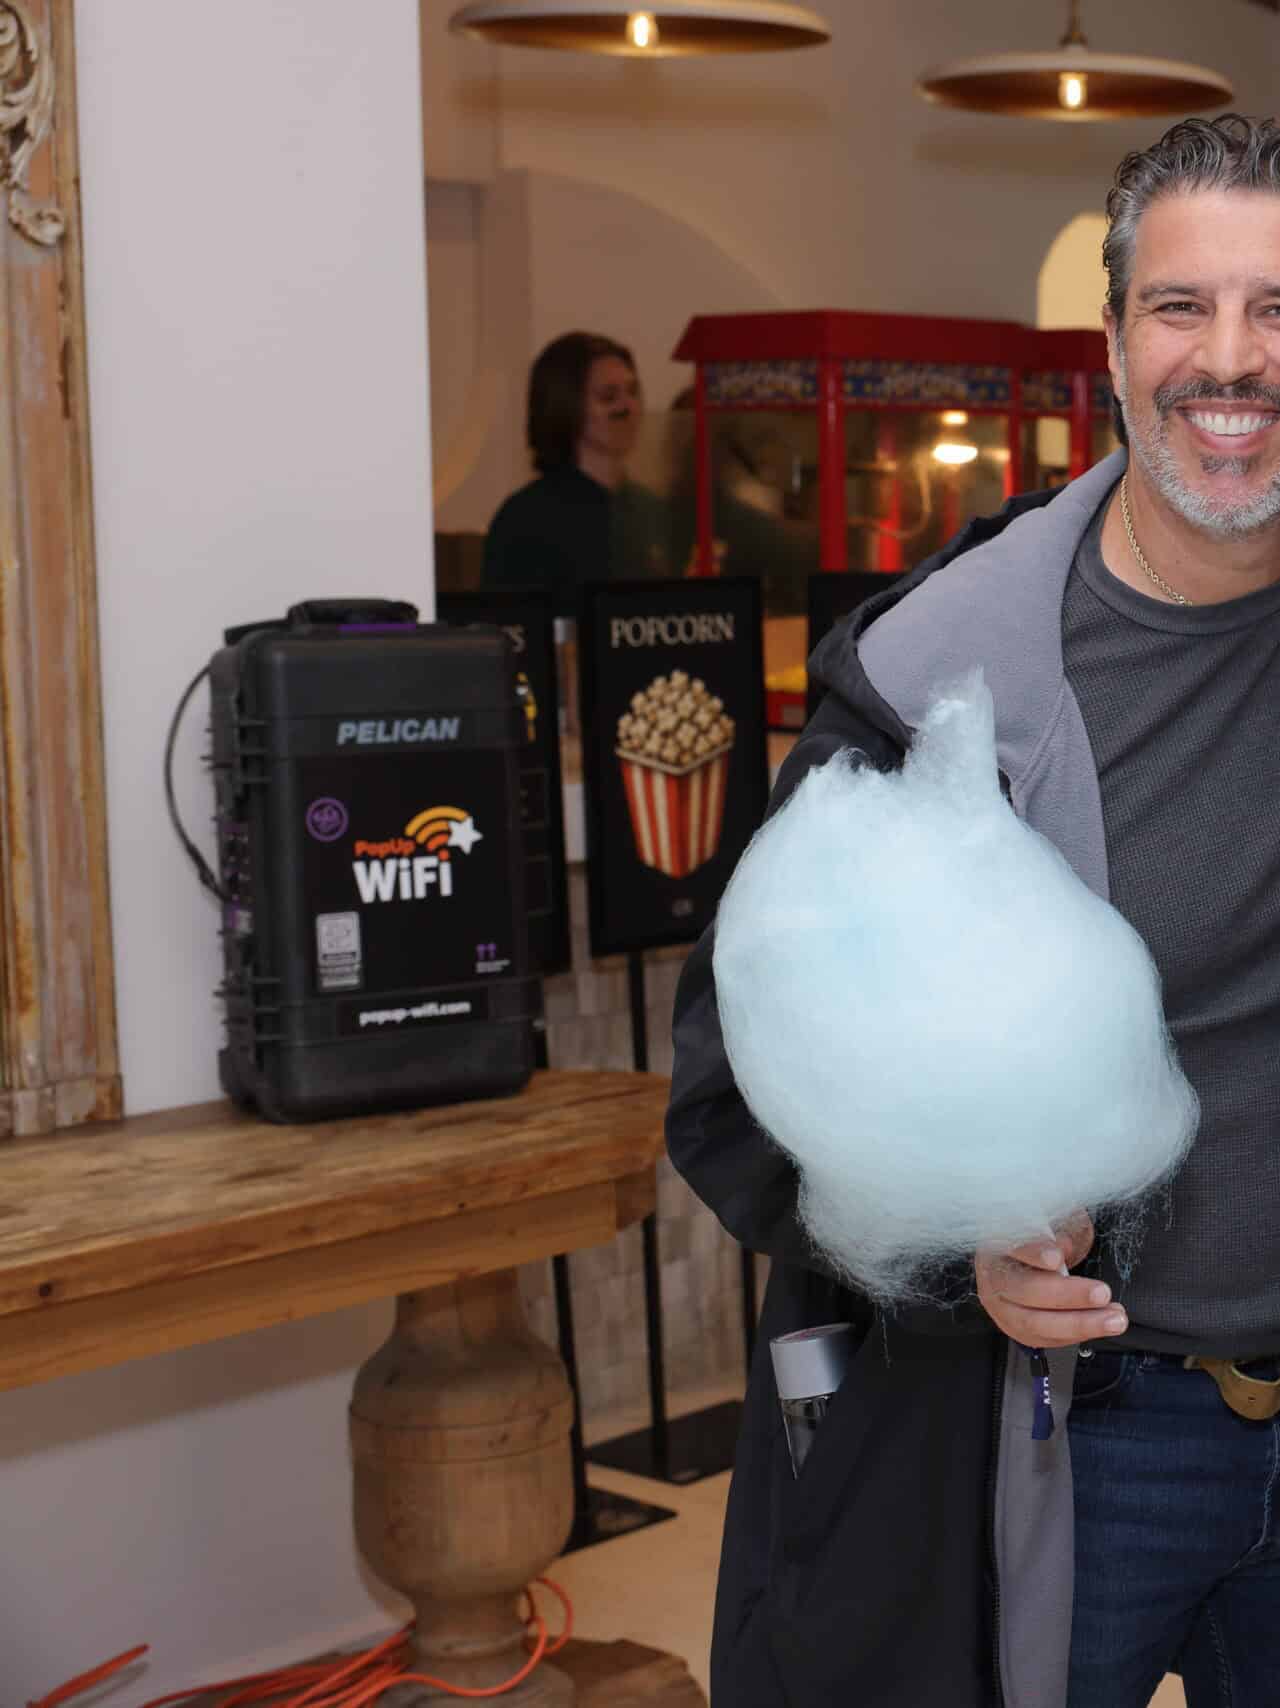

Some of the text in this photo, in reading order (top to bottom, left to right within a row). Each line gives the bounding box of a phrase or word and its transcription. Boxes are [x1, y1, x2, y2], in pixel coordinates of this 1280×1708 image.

[611, 613, 735, 648] POPCORN
[337, 717, 461, 746] PELICAN
[353, 850, 453, 904] WiFi
